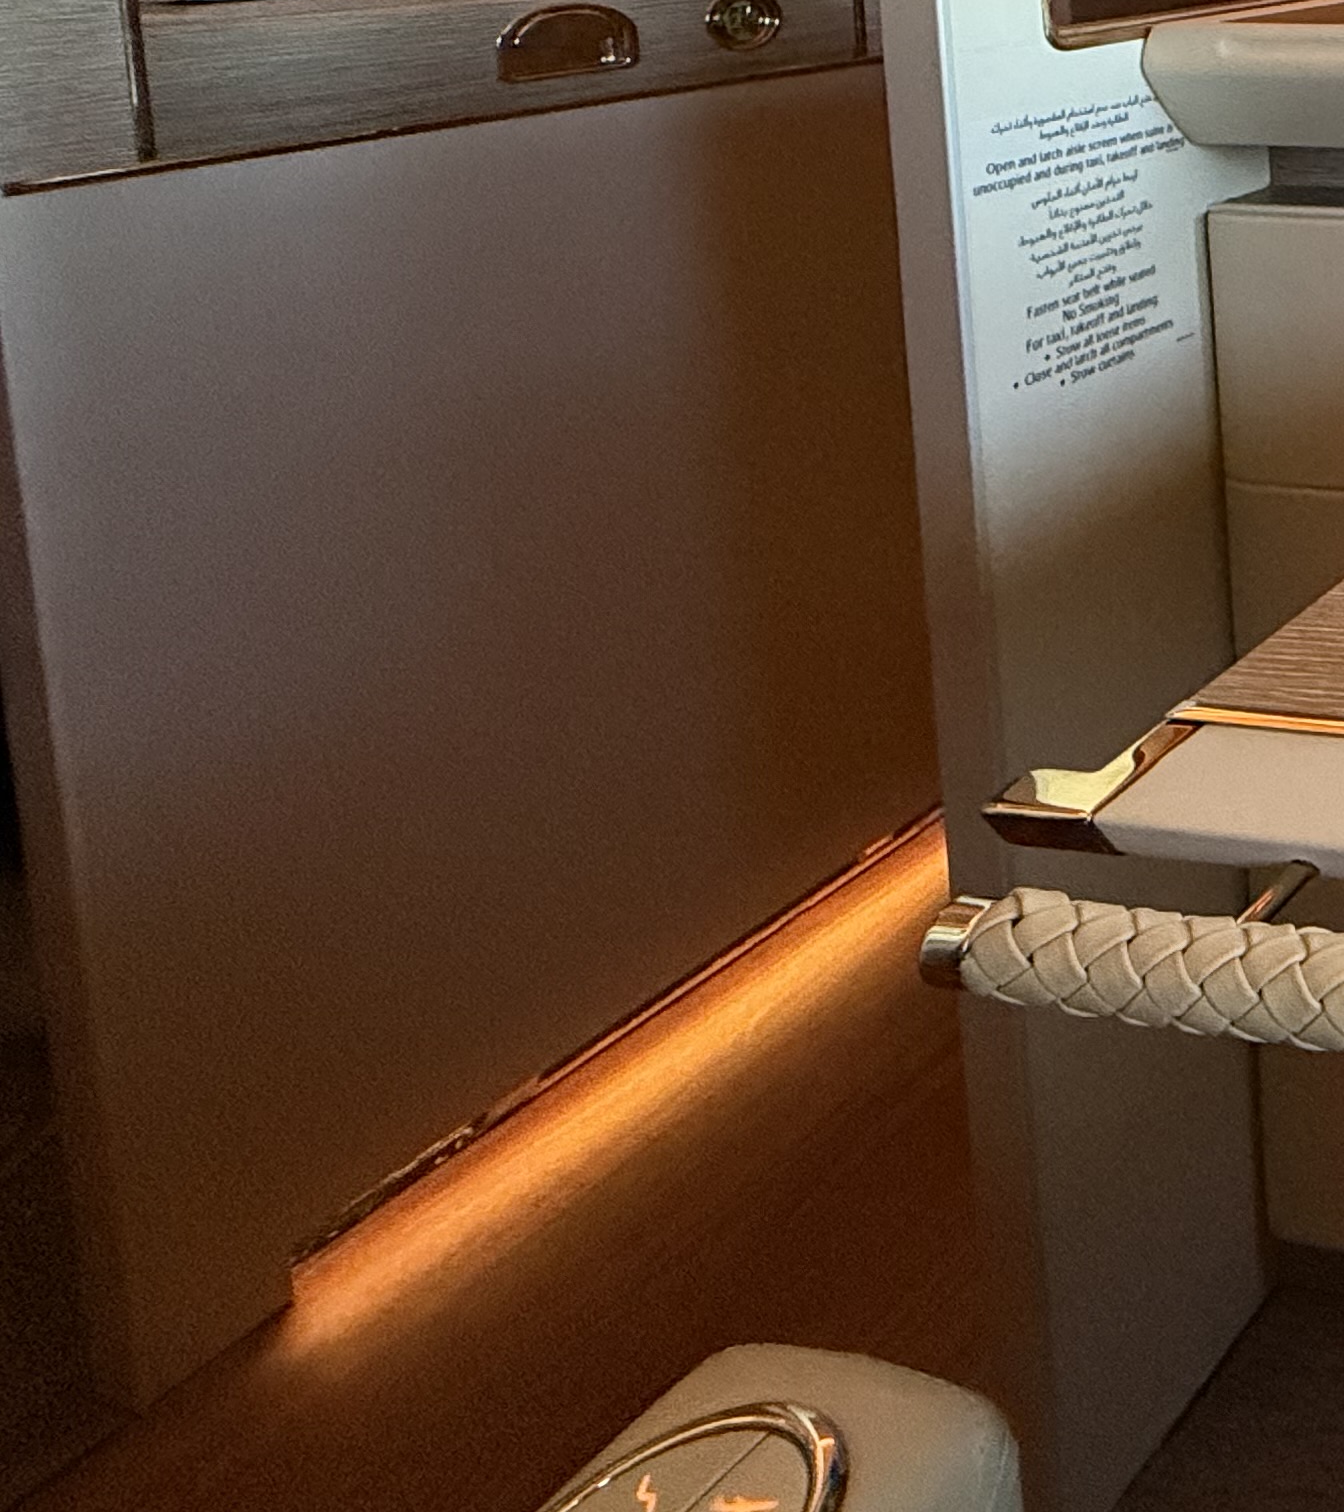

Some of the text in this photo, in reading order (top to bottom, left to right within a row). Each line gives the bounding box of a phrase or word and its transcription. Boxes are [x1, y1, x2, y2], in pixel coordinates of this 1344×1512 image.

[986, 160, 1016, 176] Open
[1018, 153, 1037, 167] and
[1040, 146, 1063, 162] latch
[973, 172, 1032, 196] unoccupied
[1034, 165, 1051, 182] and
[1054, 159, 1083, 177] during
[1026, 299, 1059, 319] Fasten
[1062, 291, 1080, 307] seat
[1083, 284, 1100, 300] belt
[1062, 293, 1120, 322] No Smoking
[1026, 338, 1043, 354] For
[1108, 306, 1124, 323] and
[1024, 367, 1052, 386] Close
